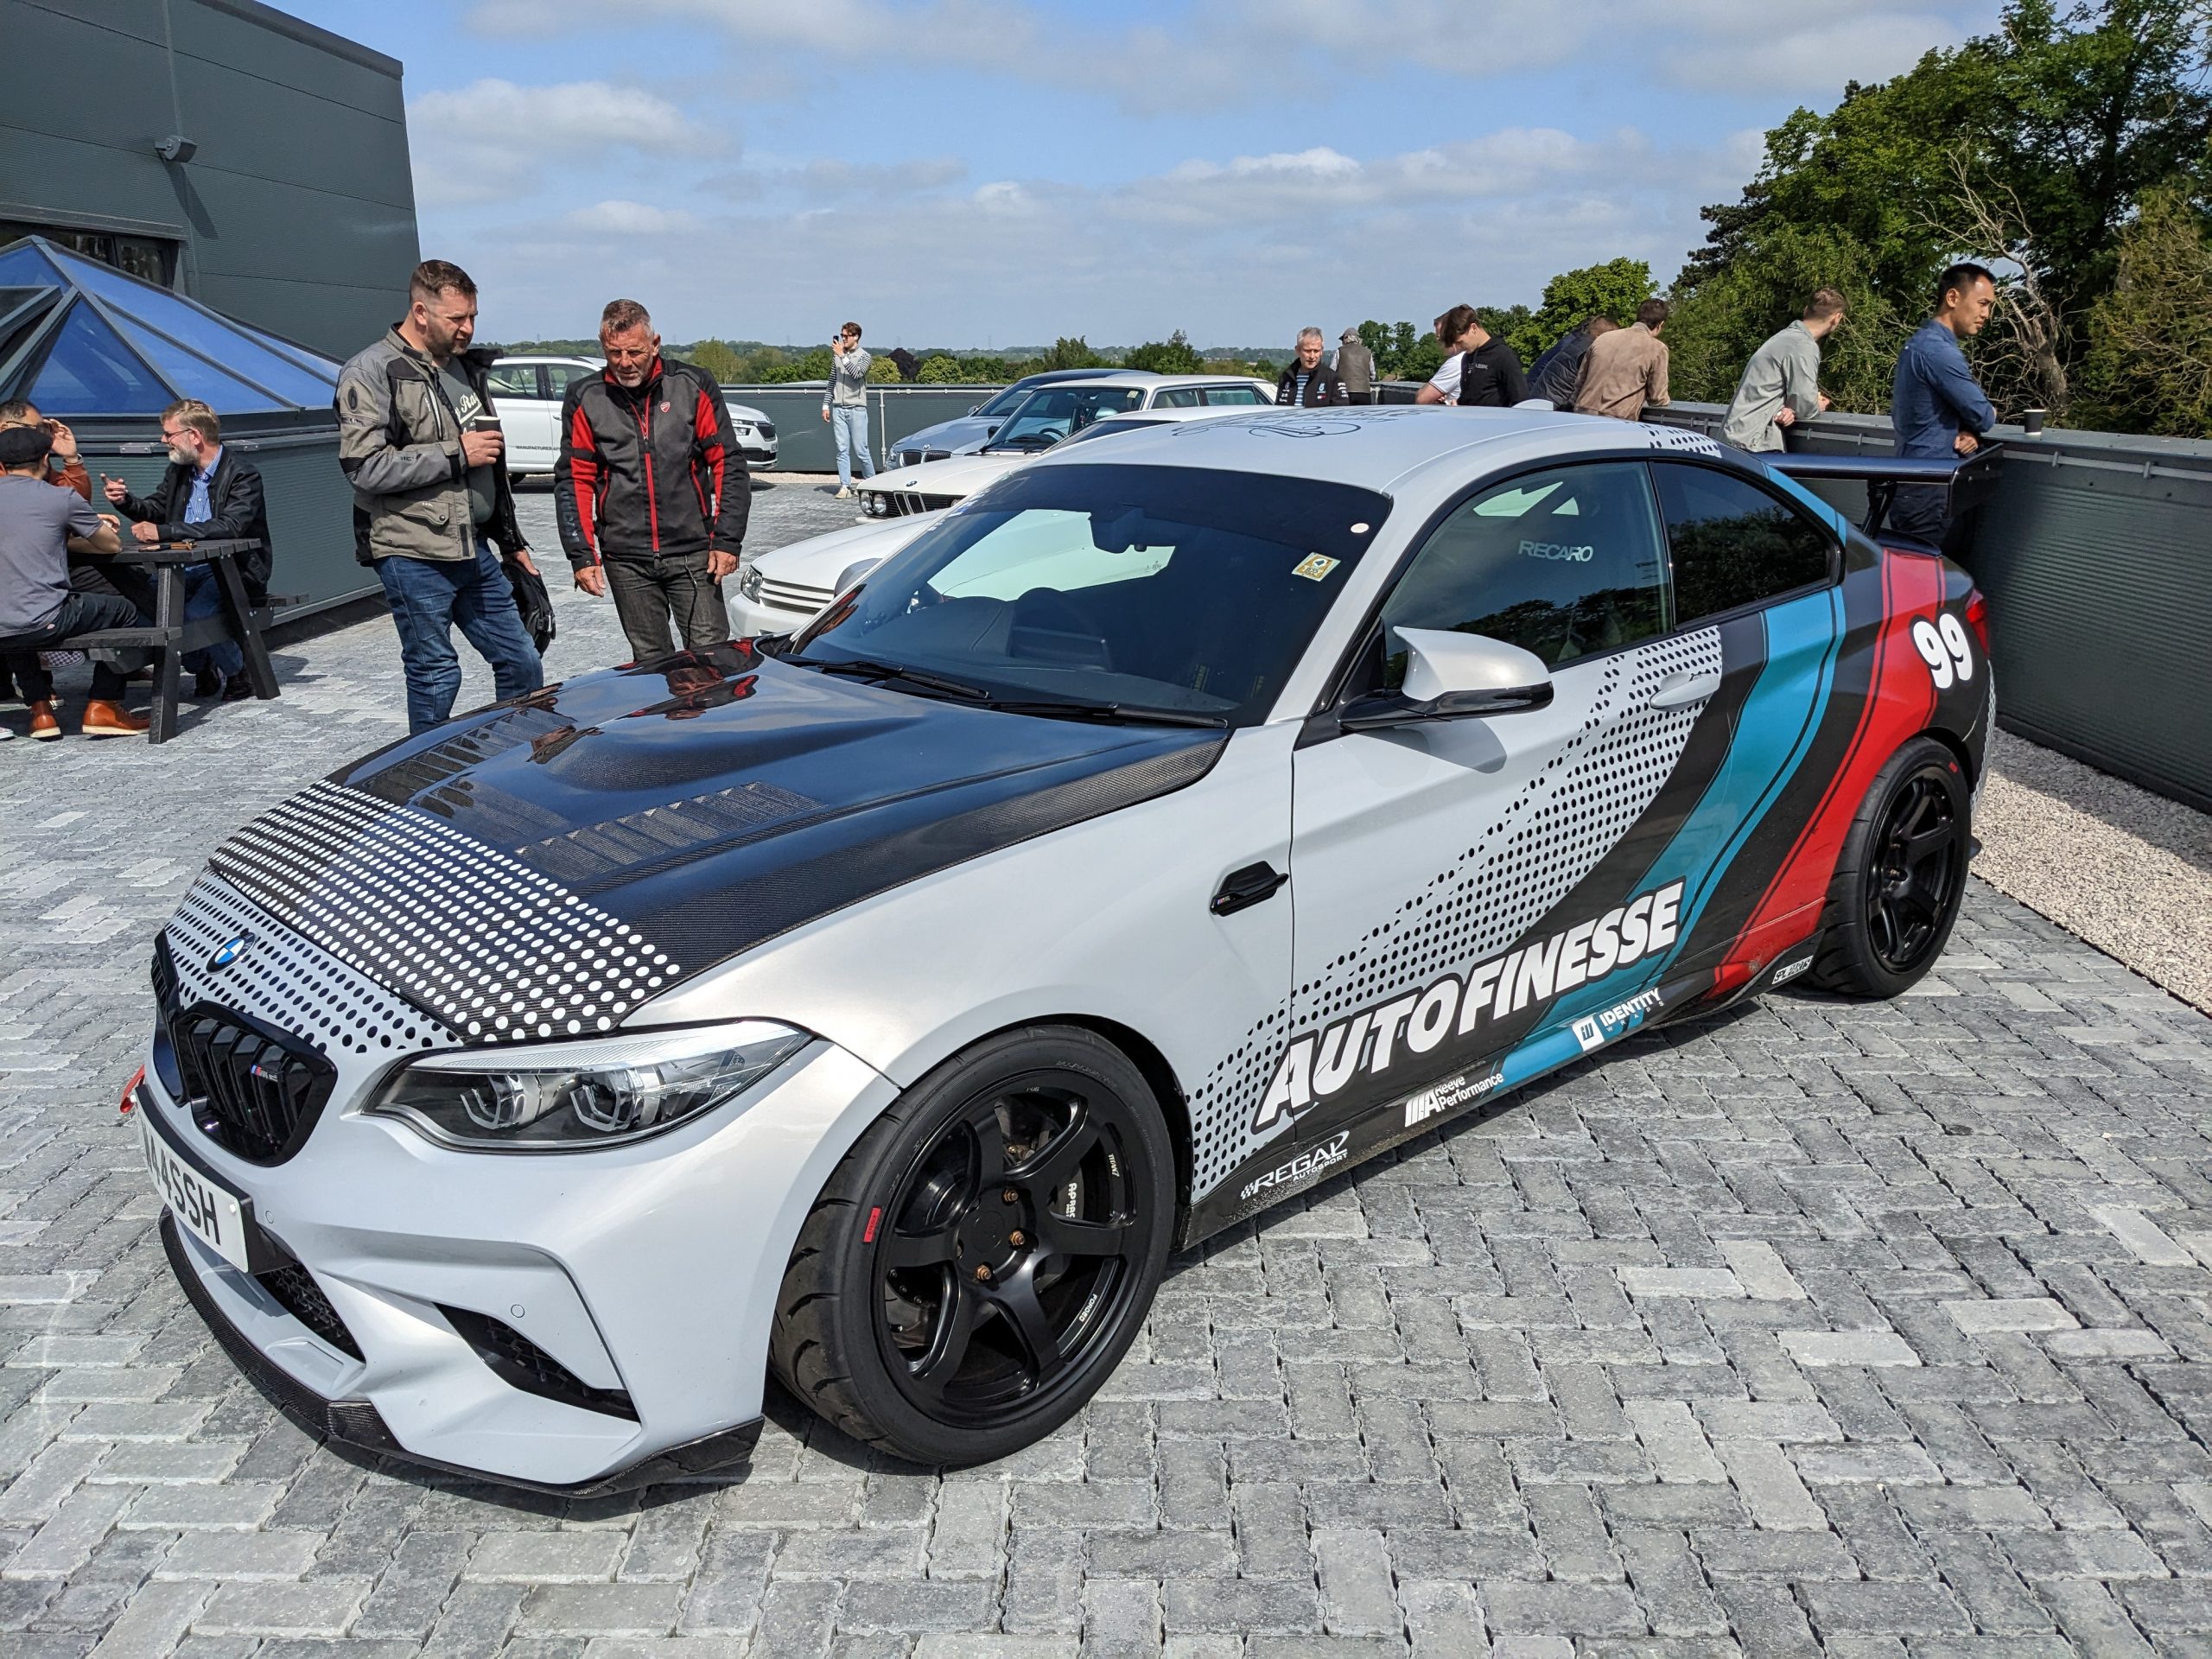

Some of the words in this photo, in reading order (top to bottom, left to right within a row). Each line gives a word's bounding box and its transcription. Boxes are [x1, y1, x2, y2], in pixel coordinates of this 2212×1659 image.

[1517, 539, 1593, 562] RECARO
[1912, 613, 1973, 689] 99
[1255, 881, 1684, 1127] AUTOFINESSE
[1599, 987, 1661, 1027] IDENTITY
[1605, 1001, 1664, 1032] WRAPS
[1435, 1075, 1466, 1097] Reeve
[1438, 1072, 1504, 1110] Performance
[1252, 1130, 1350, 1195] REGAL
[1293, 1152, 1348, 1182] AUTOSPORT
[1078, 1293, 1098, 1322] FORGED
